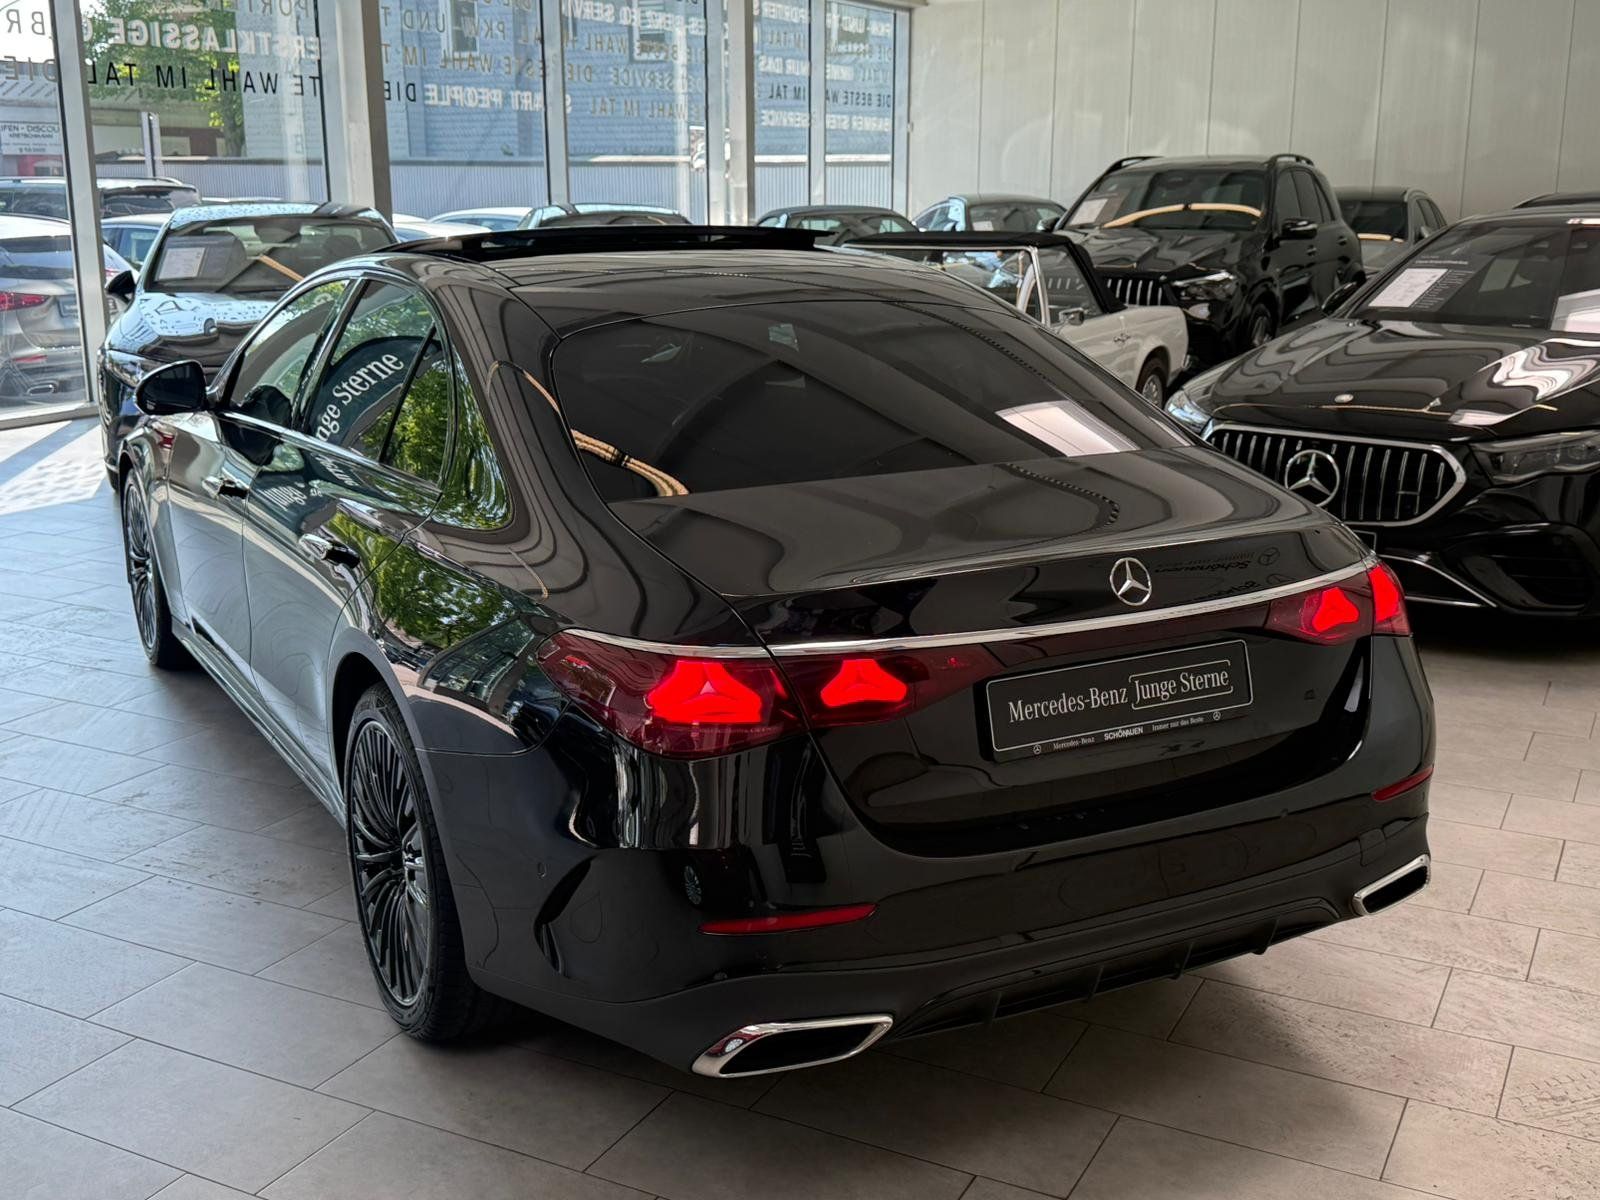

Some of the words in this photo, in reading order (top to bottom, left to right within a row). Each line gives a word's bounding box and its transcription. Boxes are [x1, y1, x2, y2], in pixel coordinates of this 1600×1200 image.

[332, 353, 405, 406] Sterne
[1008, 686, 1128, 723] Mercedes-Benz
[1133, 679, 1177, 704] Junge
[1180, 668, 1229, 692] Sterne
